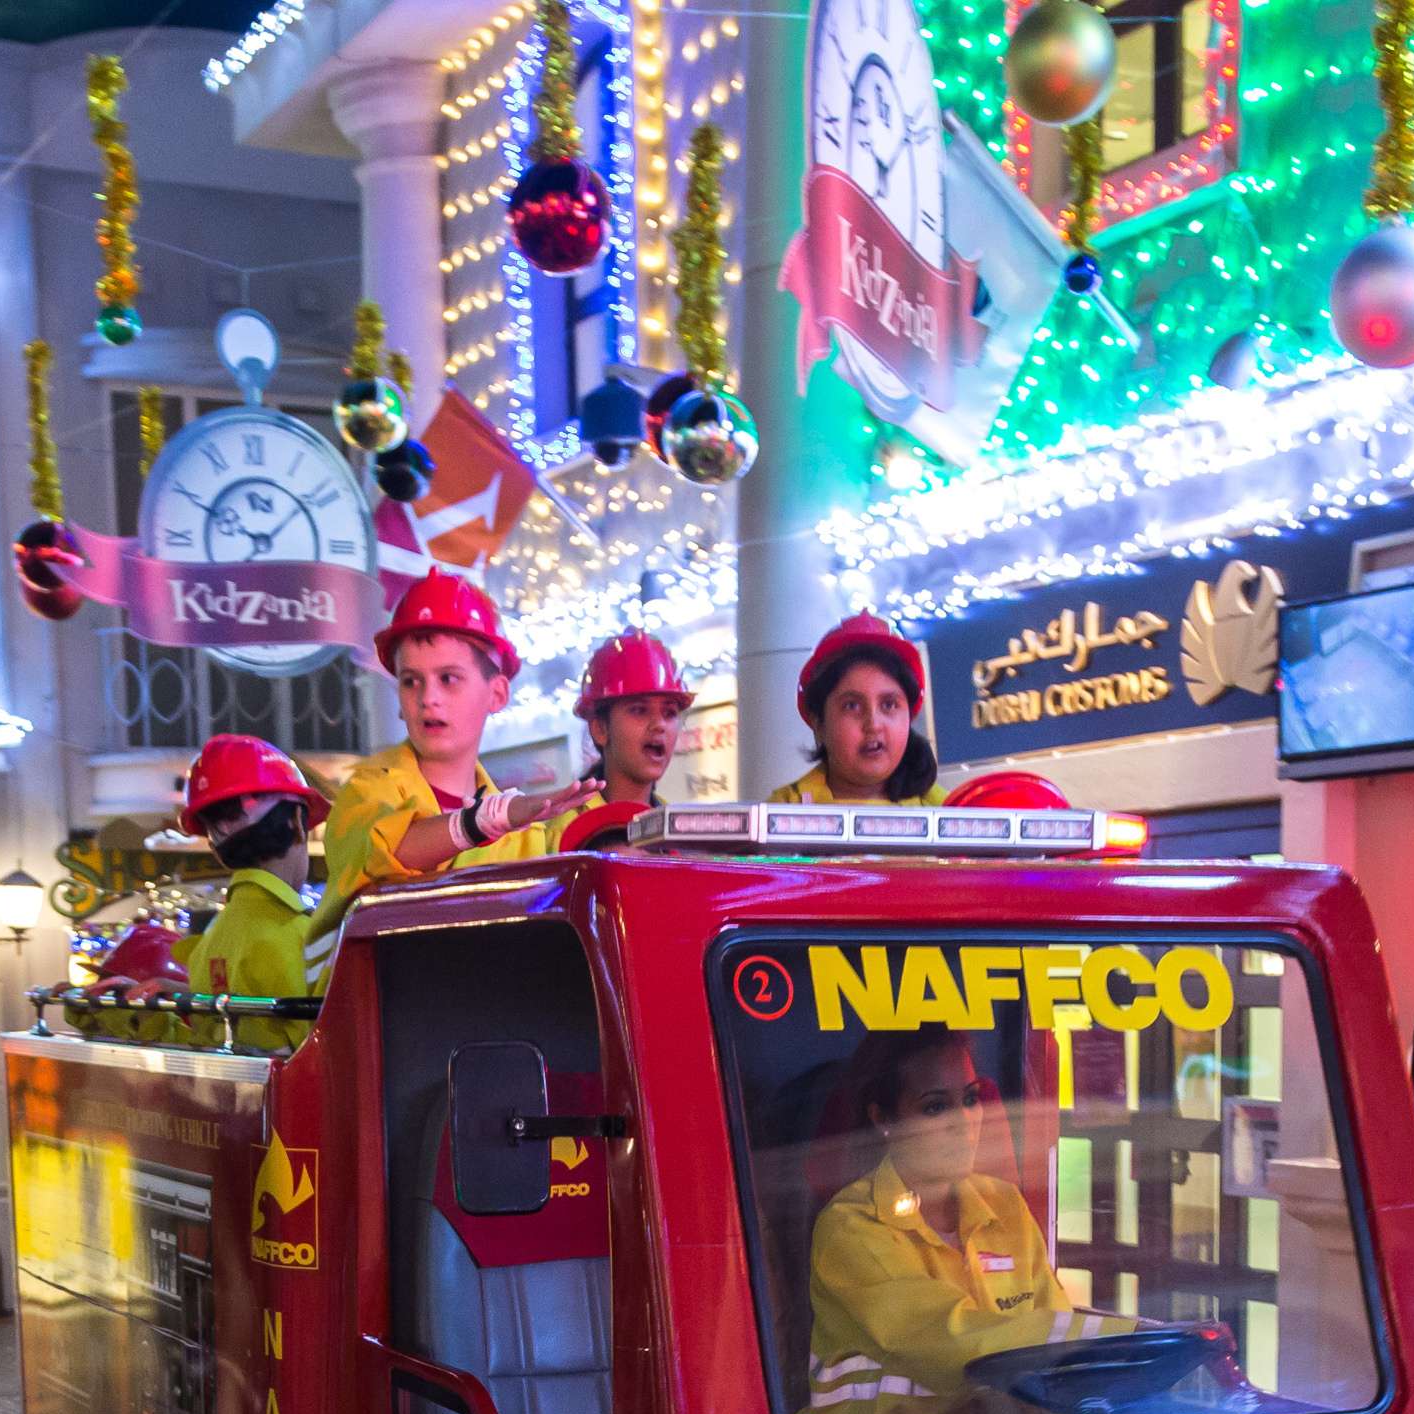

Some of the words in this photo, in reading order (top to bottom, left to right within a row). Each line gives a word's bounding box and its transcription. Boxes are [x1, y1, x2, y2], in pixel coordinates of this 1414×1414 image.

[169, 578, 339, 626] KidZania
[751, 969, 773, 1003] 2
[807, 945, 1234, 1032] NAFFCO
[549, 1182, 590, 1198] FFCO
[251, 1236, 315, 1265] NAFFCO
